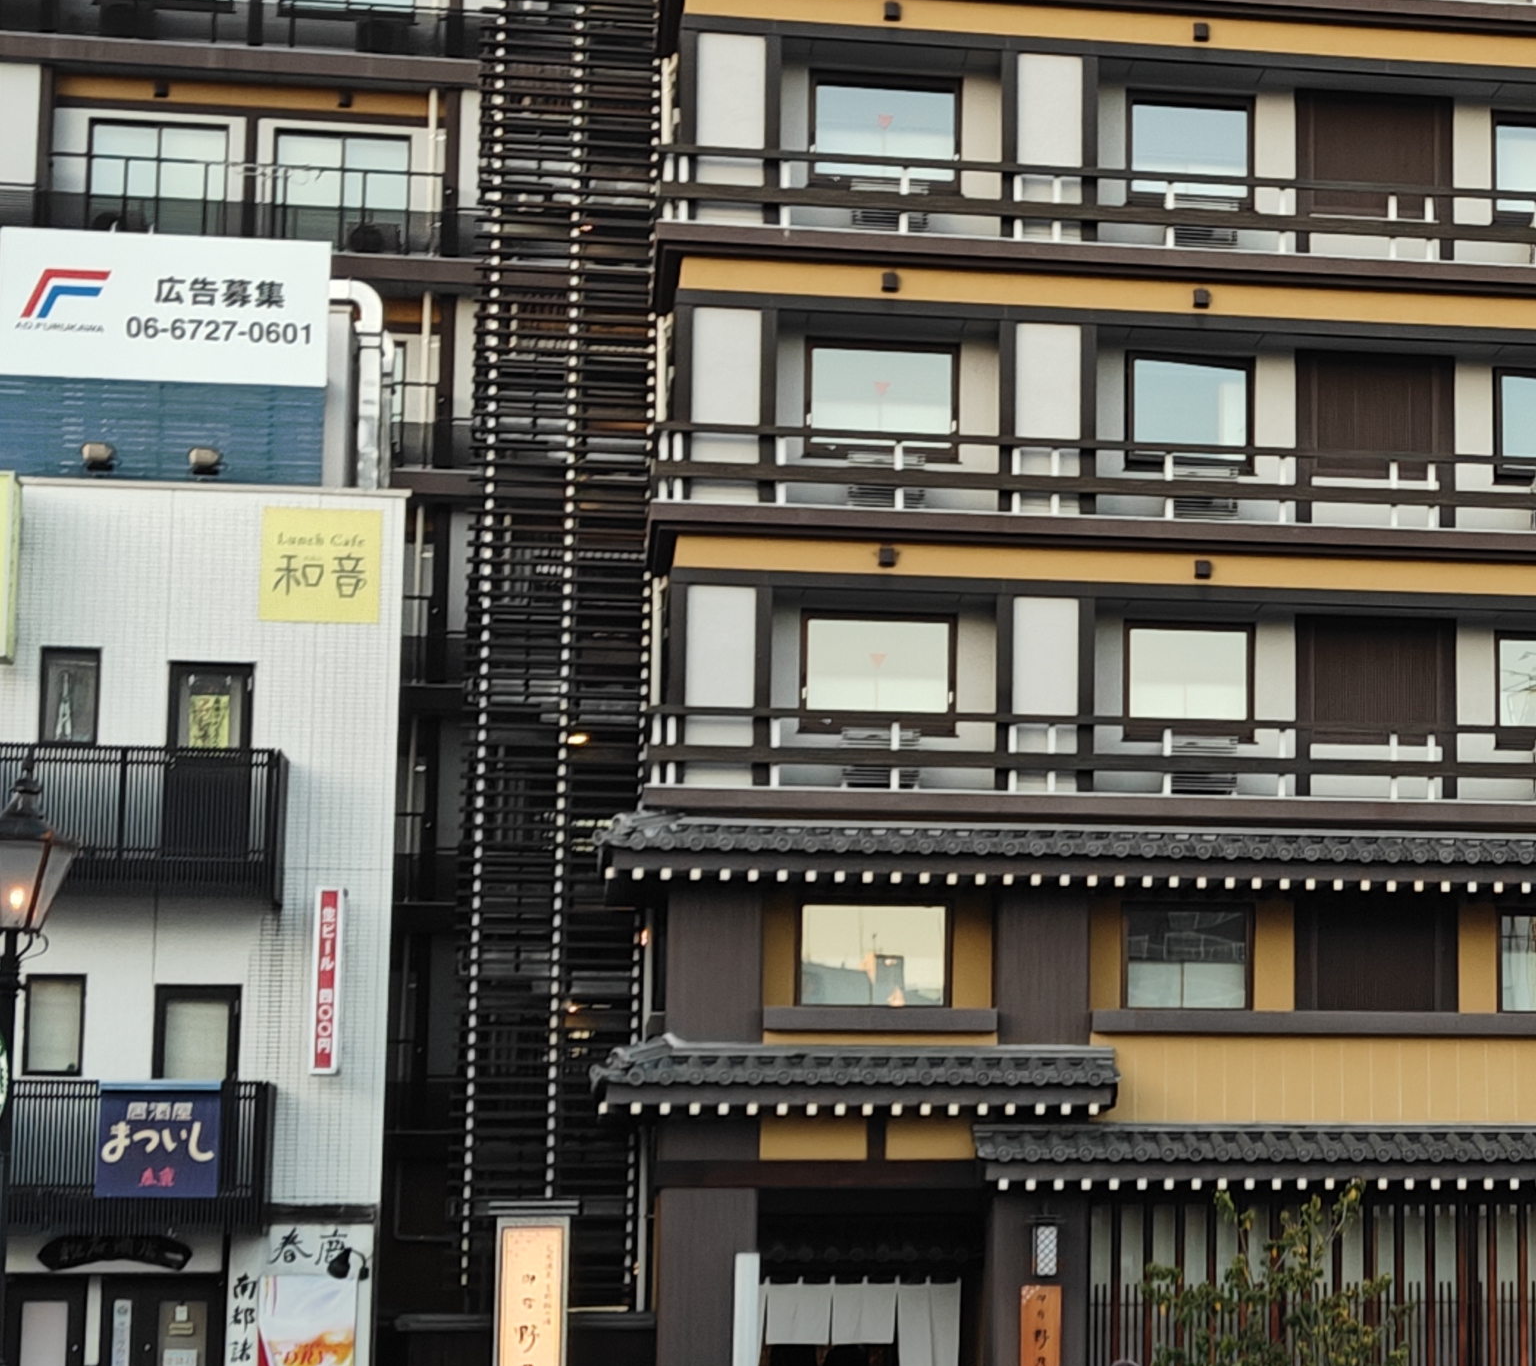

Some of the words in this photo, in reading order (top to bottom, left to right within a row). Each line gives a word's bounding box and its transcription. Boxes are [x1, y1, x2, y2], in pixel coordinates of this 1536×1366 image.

[155, 276, 286, 309] 広告募集
[126, 316, 312, 345] 06-6727-0601
[277, 532, 325, 546] Lunch
[271, 552, 368, 598] 和音
[320, 906, 336, 971] 生ビール
[126, 1101, 194, 1122] 居酒屋
[101, 1120, 215, 1163] まついし
